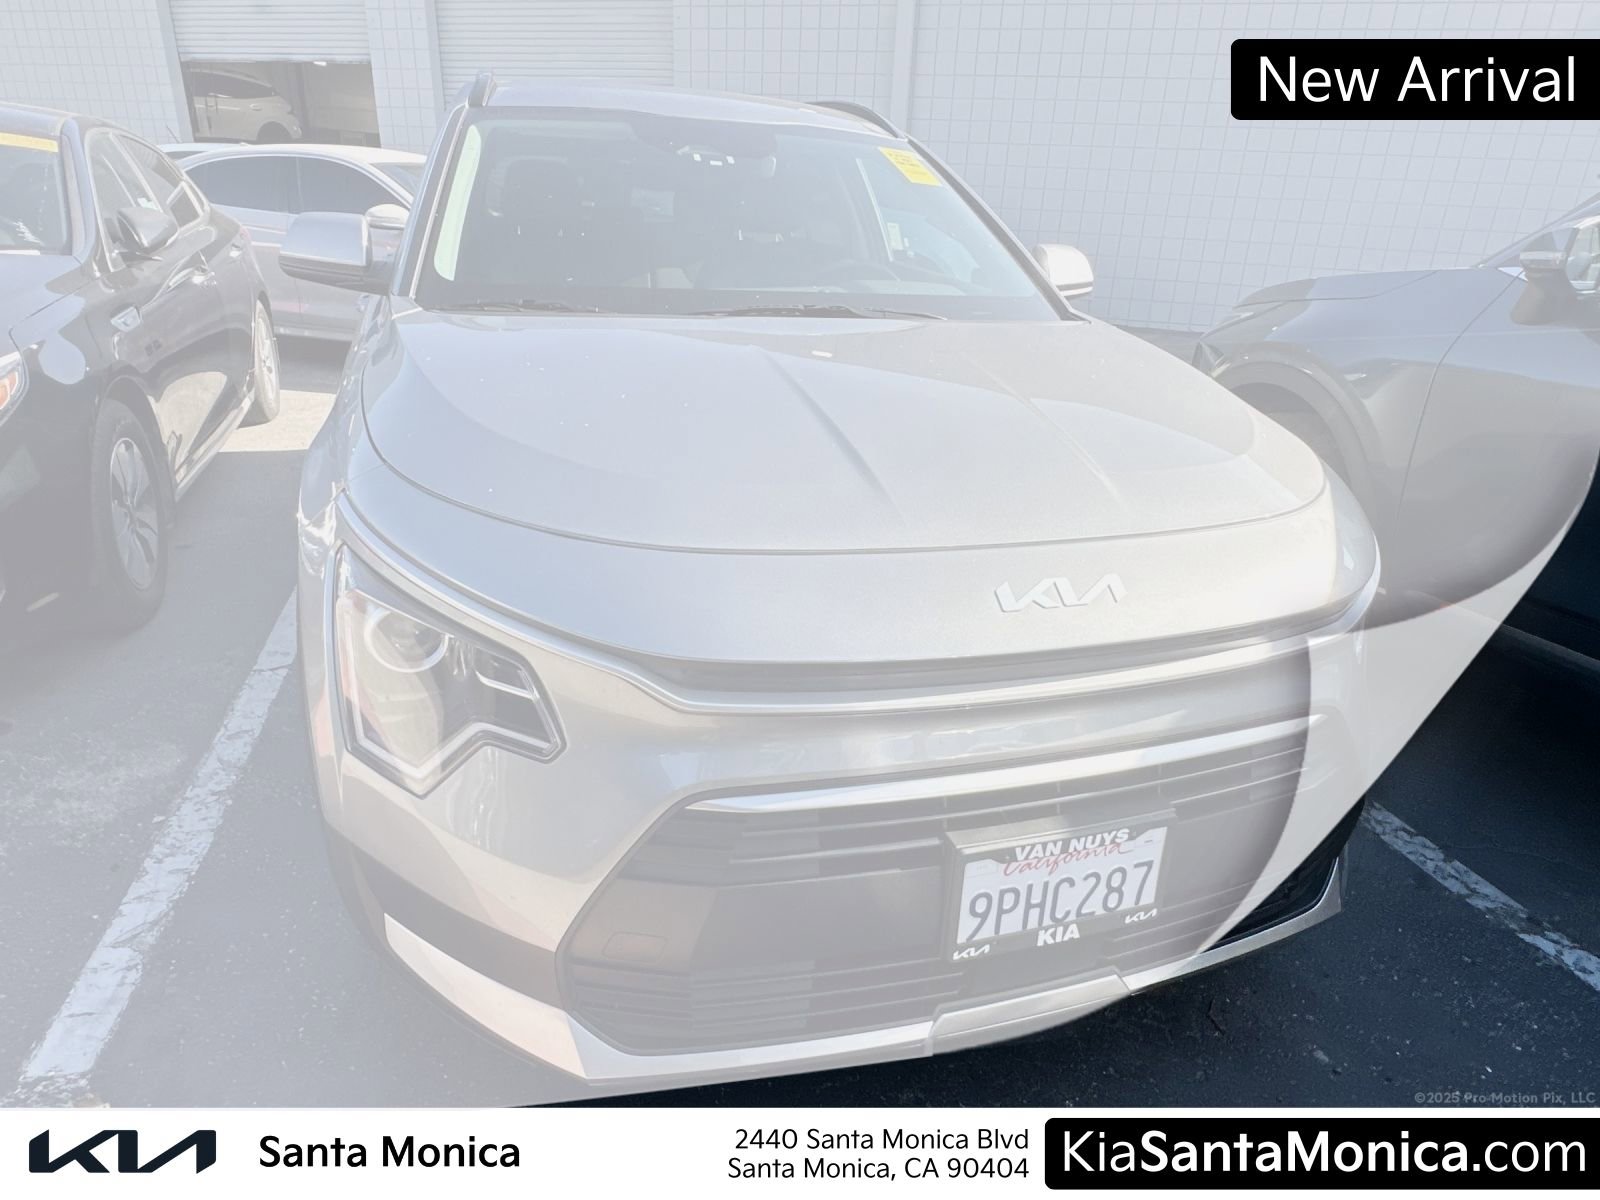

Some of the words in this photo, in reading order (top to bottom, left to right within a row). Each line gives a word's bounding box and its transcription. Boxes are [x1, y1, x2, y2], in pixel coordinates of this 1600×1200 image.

[993, 573, 1128, 613] KIA
[1015, 840, 1062, 861] VAN
[1069, 828, 1130, 852] NUYS
[965, 859, 1155, 944] 9PHC287
[1037, 923, 1080, 947] KIA
